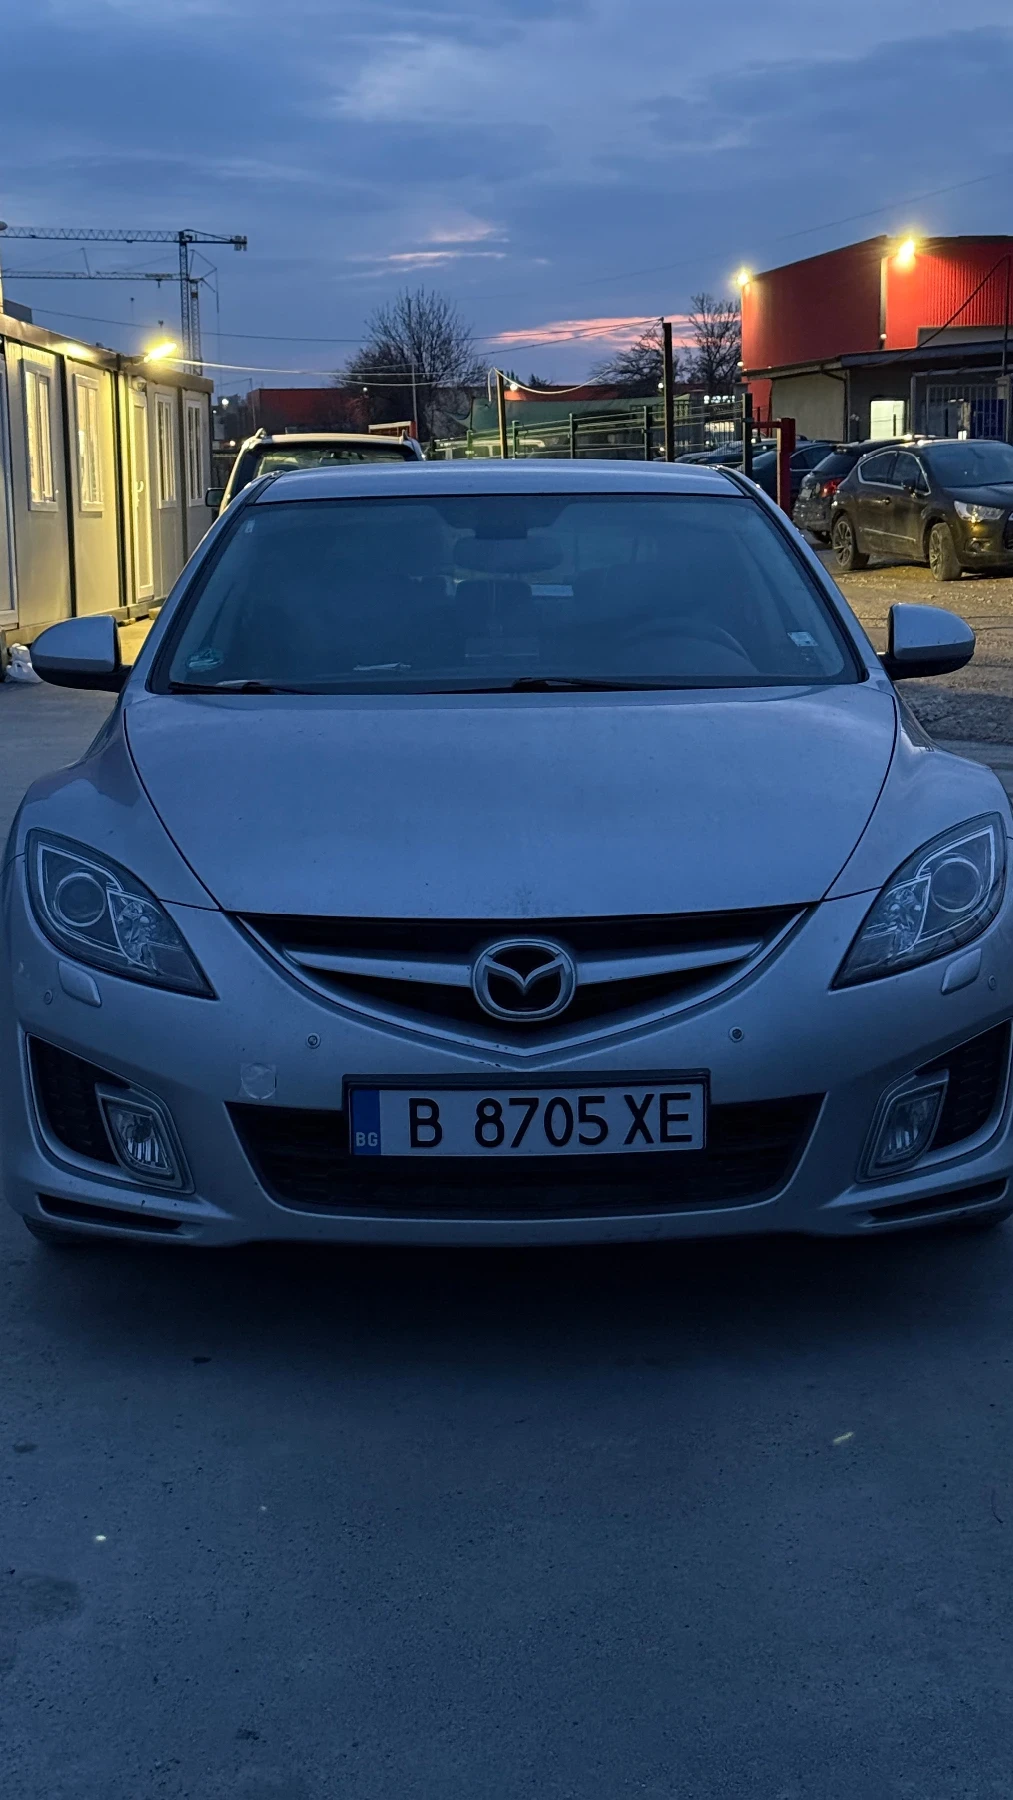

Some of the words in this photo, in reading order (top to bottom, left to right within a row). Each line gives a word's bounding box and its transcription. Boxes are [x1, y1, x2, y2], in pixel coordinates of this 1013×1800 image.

[407, 1097, 443, 1148] B
[474, 1096, 609, 1148] 8705
[623, 1092, 693, 1146] XE
[355, 1132, 379, 1147] BG
